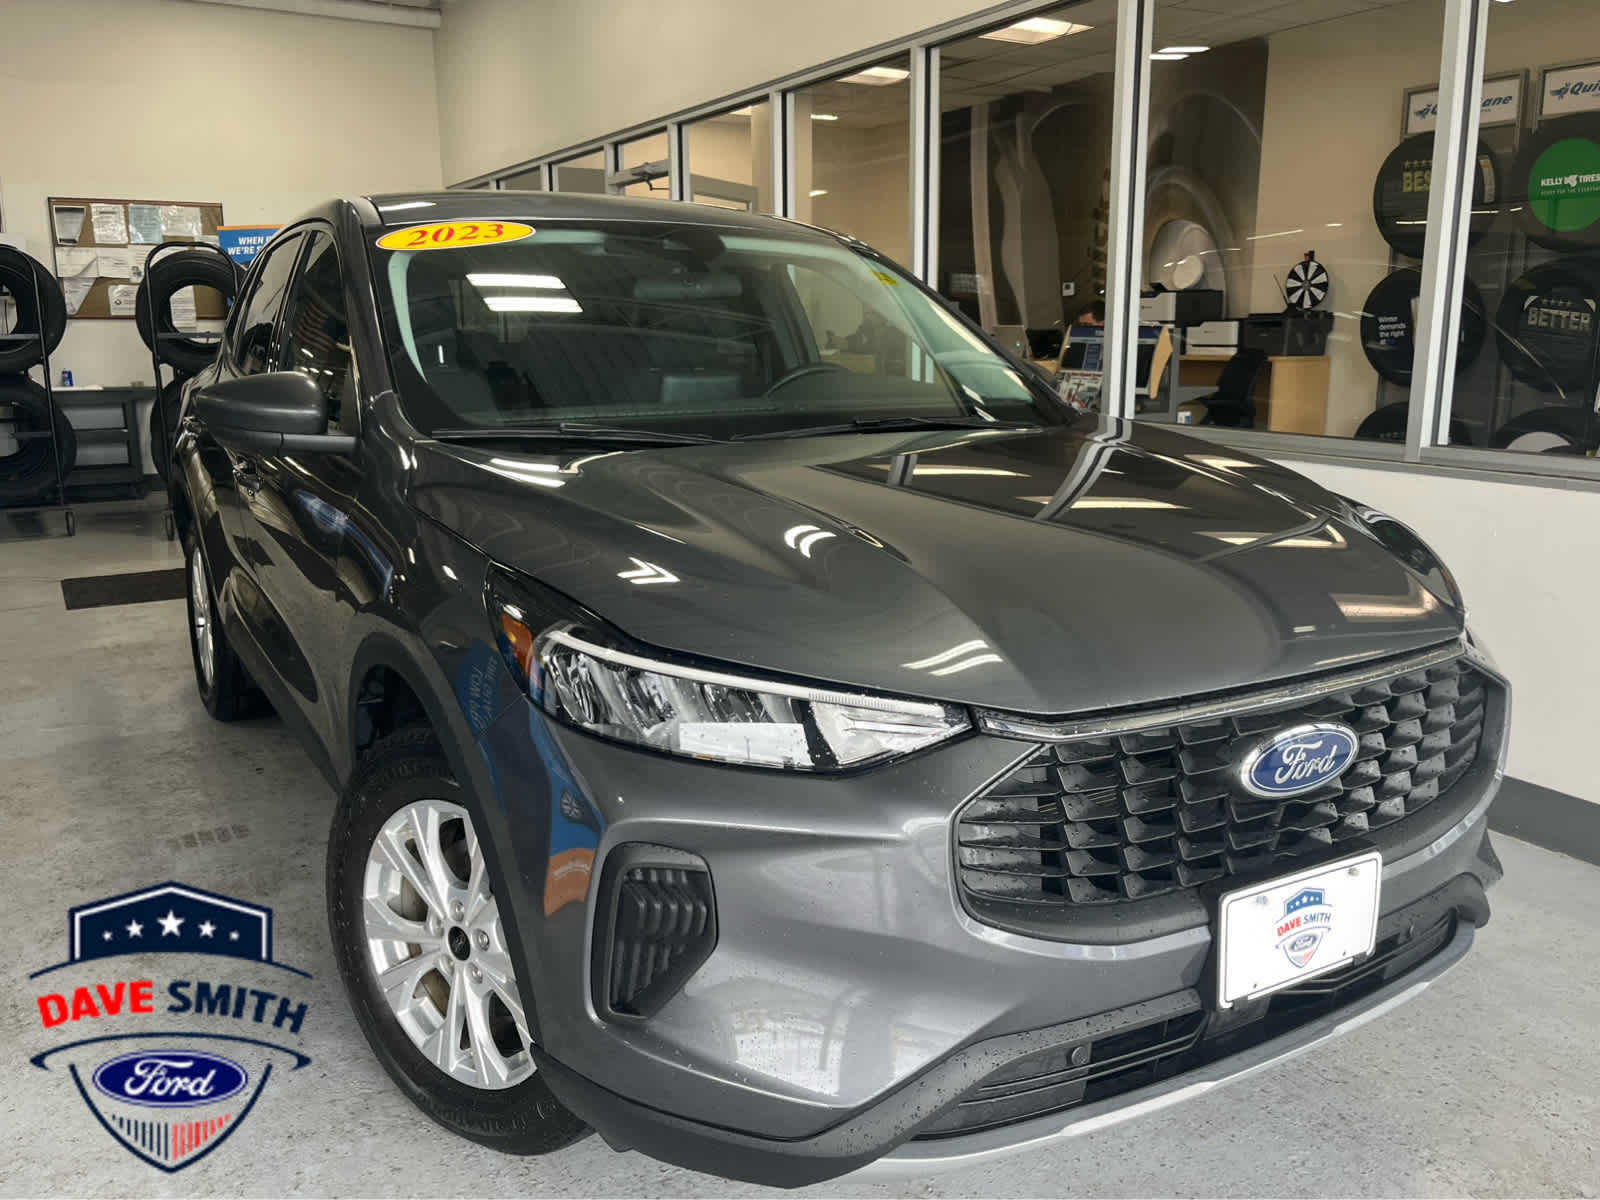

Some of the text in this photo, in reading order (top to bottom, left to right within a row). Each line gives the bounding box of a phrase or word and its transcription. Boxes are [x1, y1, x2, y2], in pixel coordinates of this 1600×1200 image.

[1570, 81, 1600, 96] Qui
[1480, 95, 1513, 108] ane
[1403, 170, 1431, 192] BES
[1541, 177, 1563, 186] KELLY
[238, 236, 264, 245] WHEN
[406, 223, 504, 247] 2023
[228, 246, 255, 255] WE'RE
[1528, 307, 1592, 331] BETTER
[1274, 740, 1339, 784] Ford
[1277, 912, 1332, 936] DAVE SMITH
